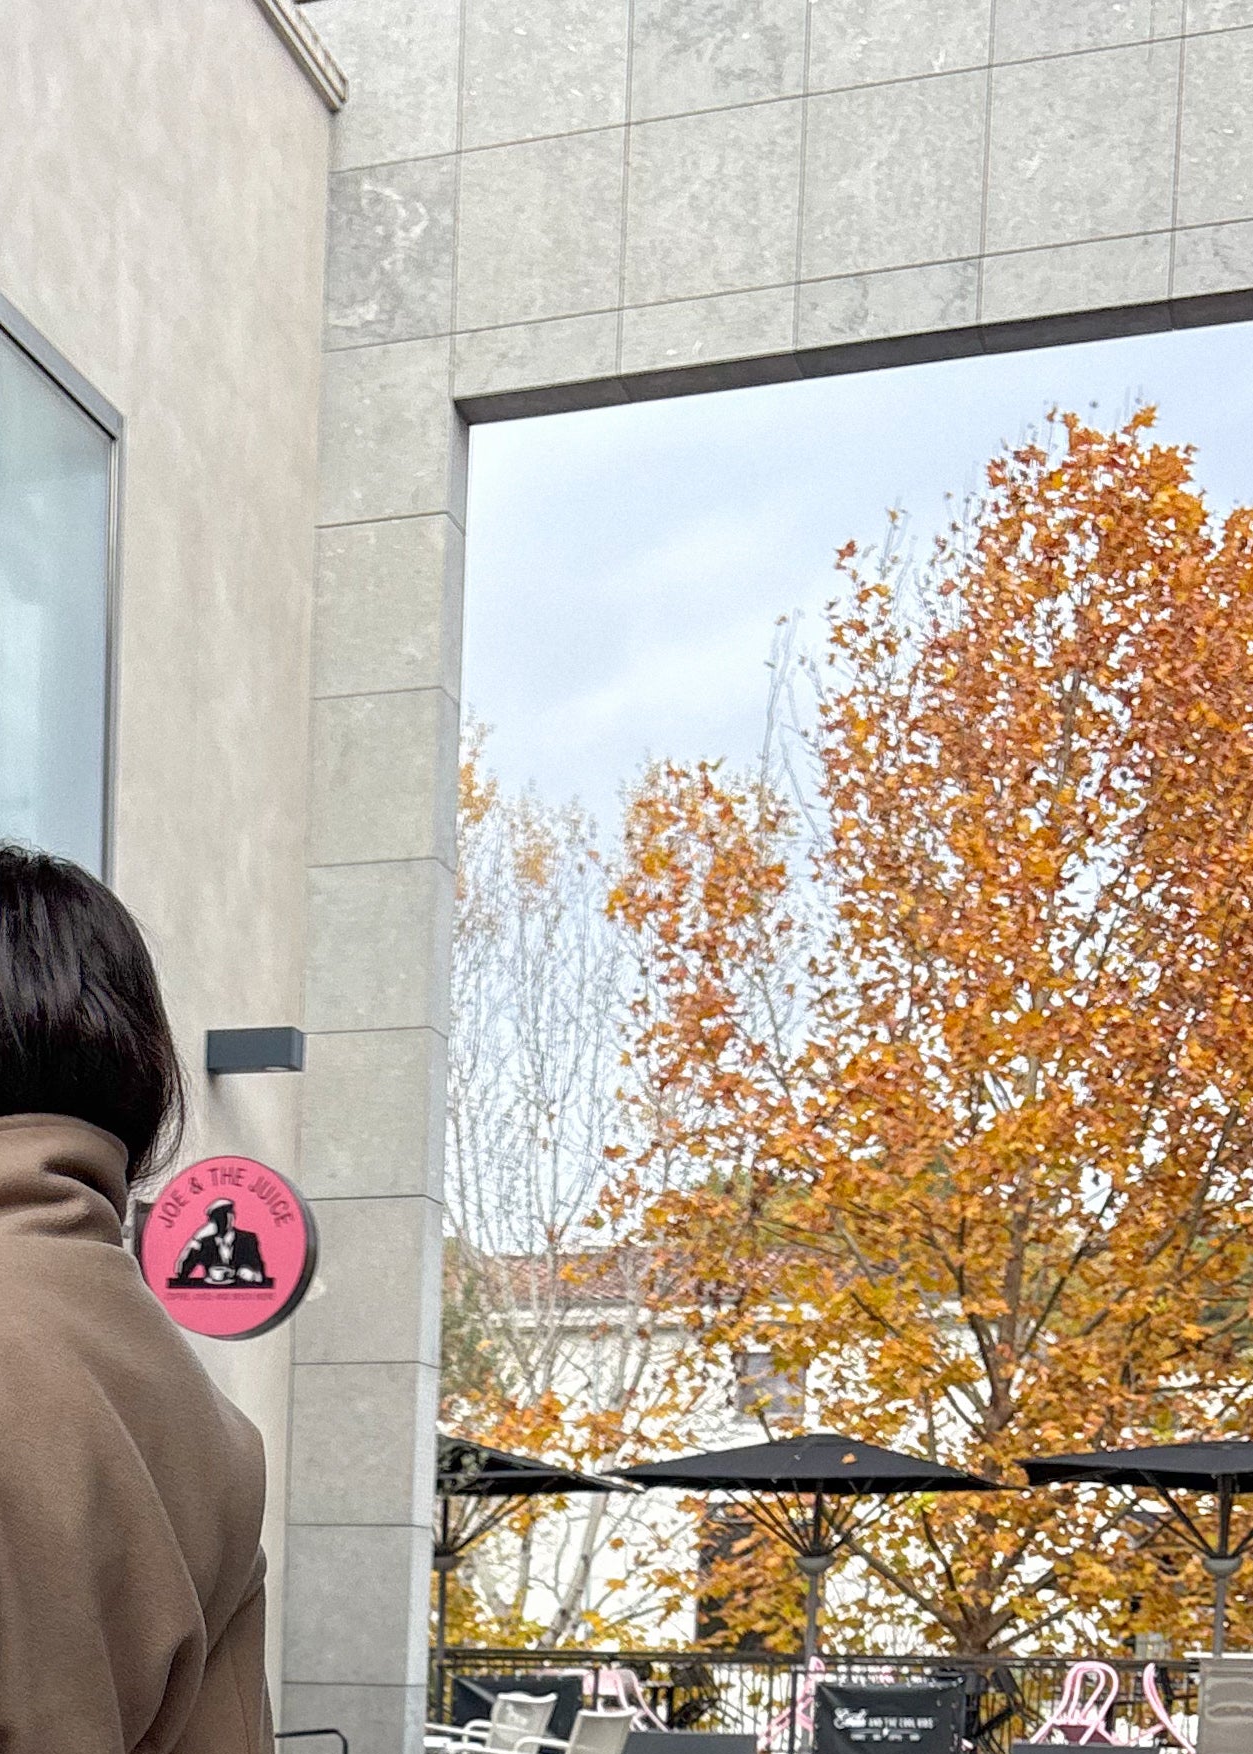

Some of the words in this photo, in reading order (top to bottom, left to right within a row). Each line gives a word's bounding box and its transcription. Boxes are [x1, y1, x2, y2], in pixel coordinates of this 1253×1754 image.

[157, 1189, 190, 1229] JOE
[188, 1176, 205, 1195] &
[207, 1166, 248, 1187] THE
[248, 1176, 294, 1228] JUICE
